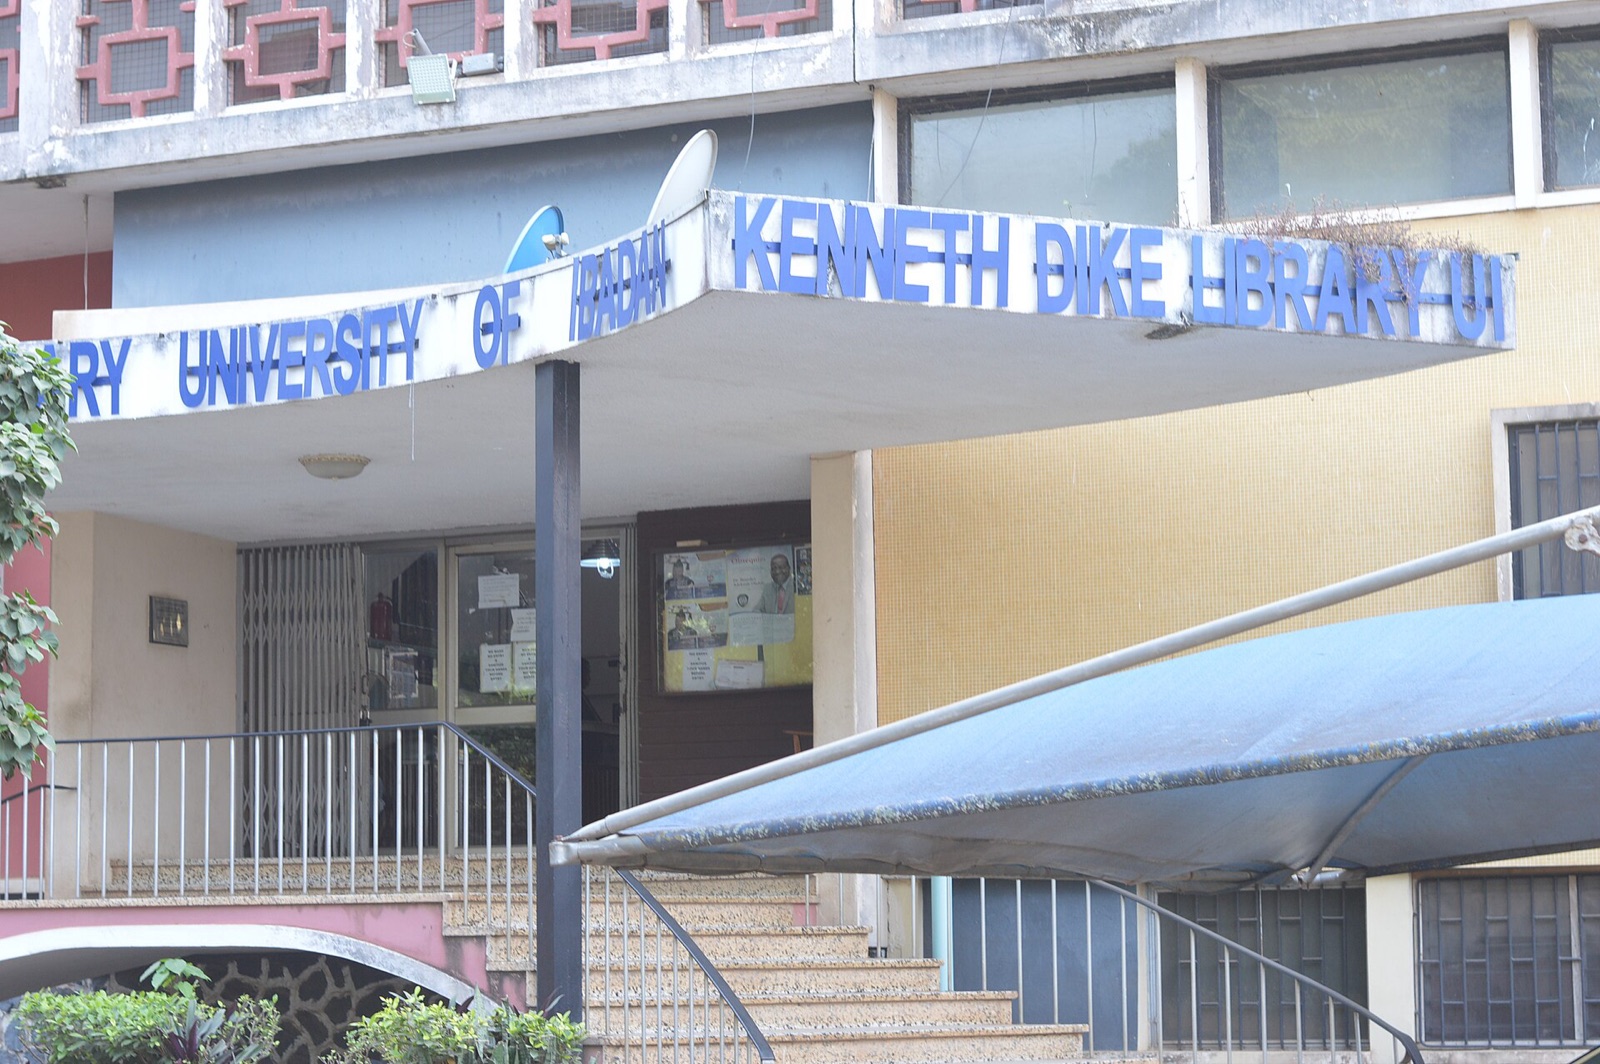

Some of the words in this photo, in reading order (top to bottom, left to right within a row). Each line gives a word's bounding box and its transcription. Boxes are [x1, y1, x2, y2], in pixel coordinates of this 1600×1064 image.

[178, 298, 425, 408] UNIVERSITY
[472, 280, 520, 370] OF
[568, 218, 667, 342] IBADAN
[734, 196, 1010, 307] KENNETH
[1035, 222, 1166, 318] DIKE
[1191, 235, 1432, 337] LIBRARY
[1450, 252, 1505, 342] UI
